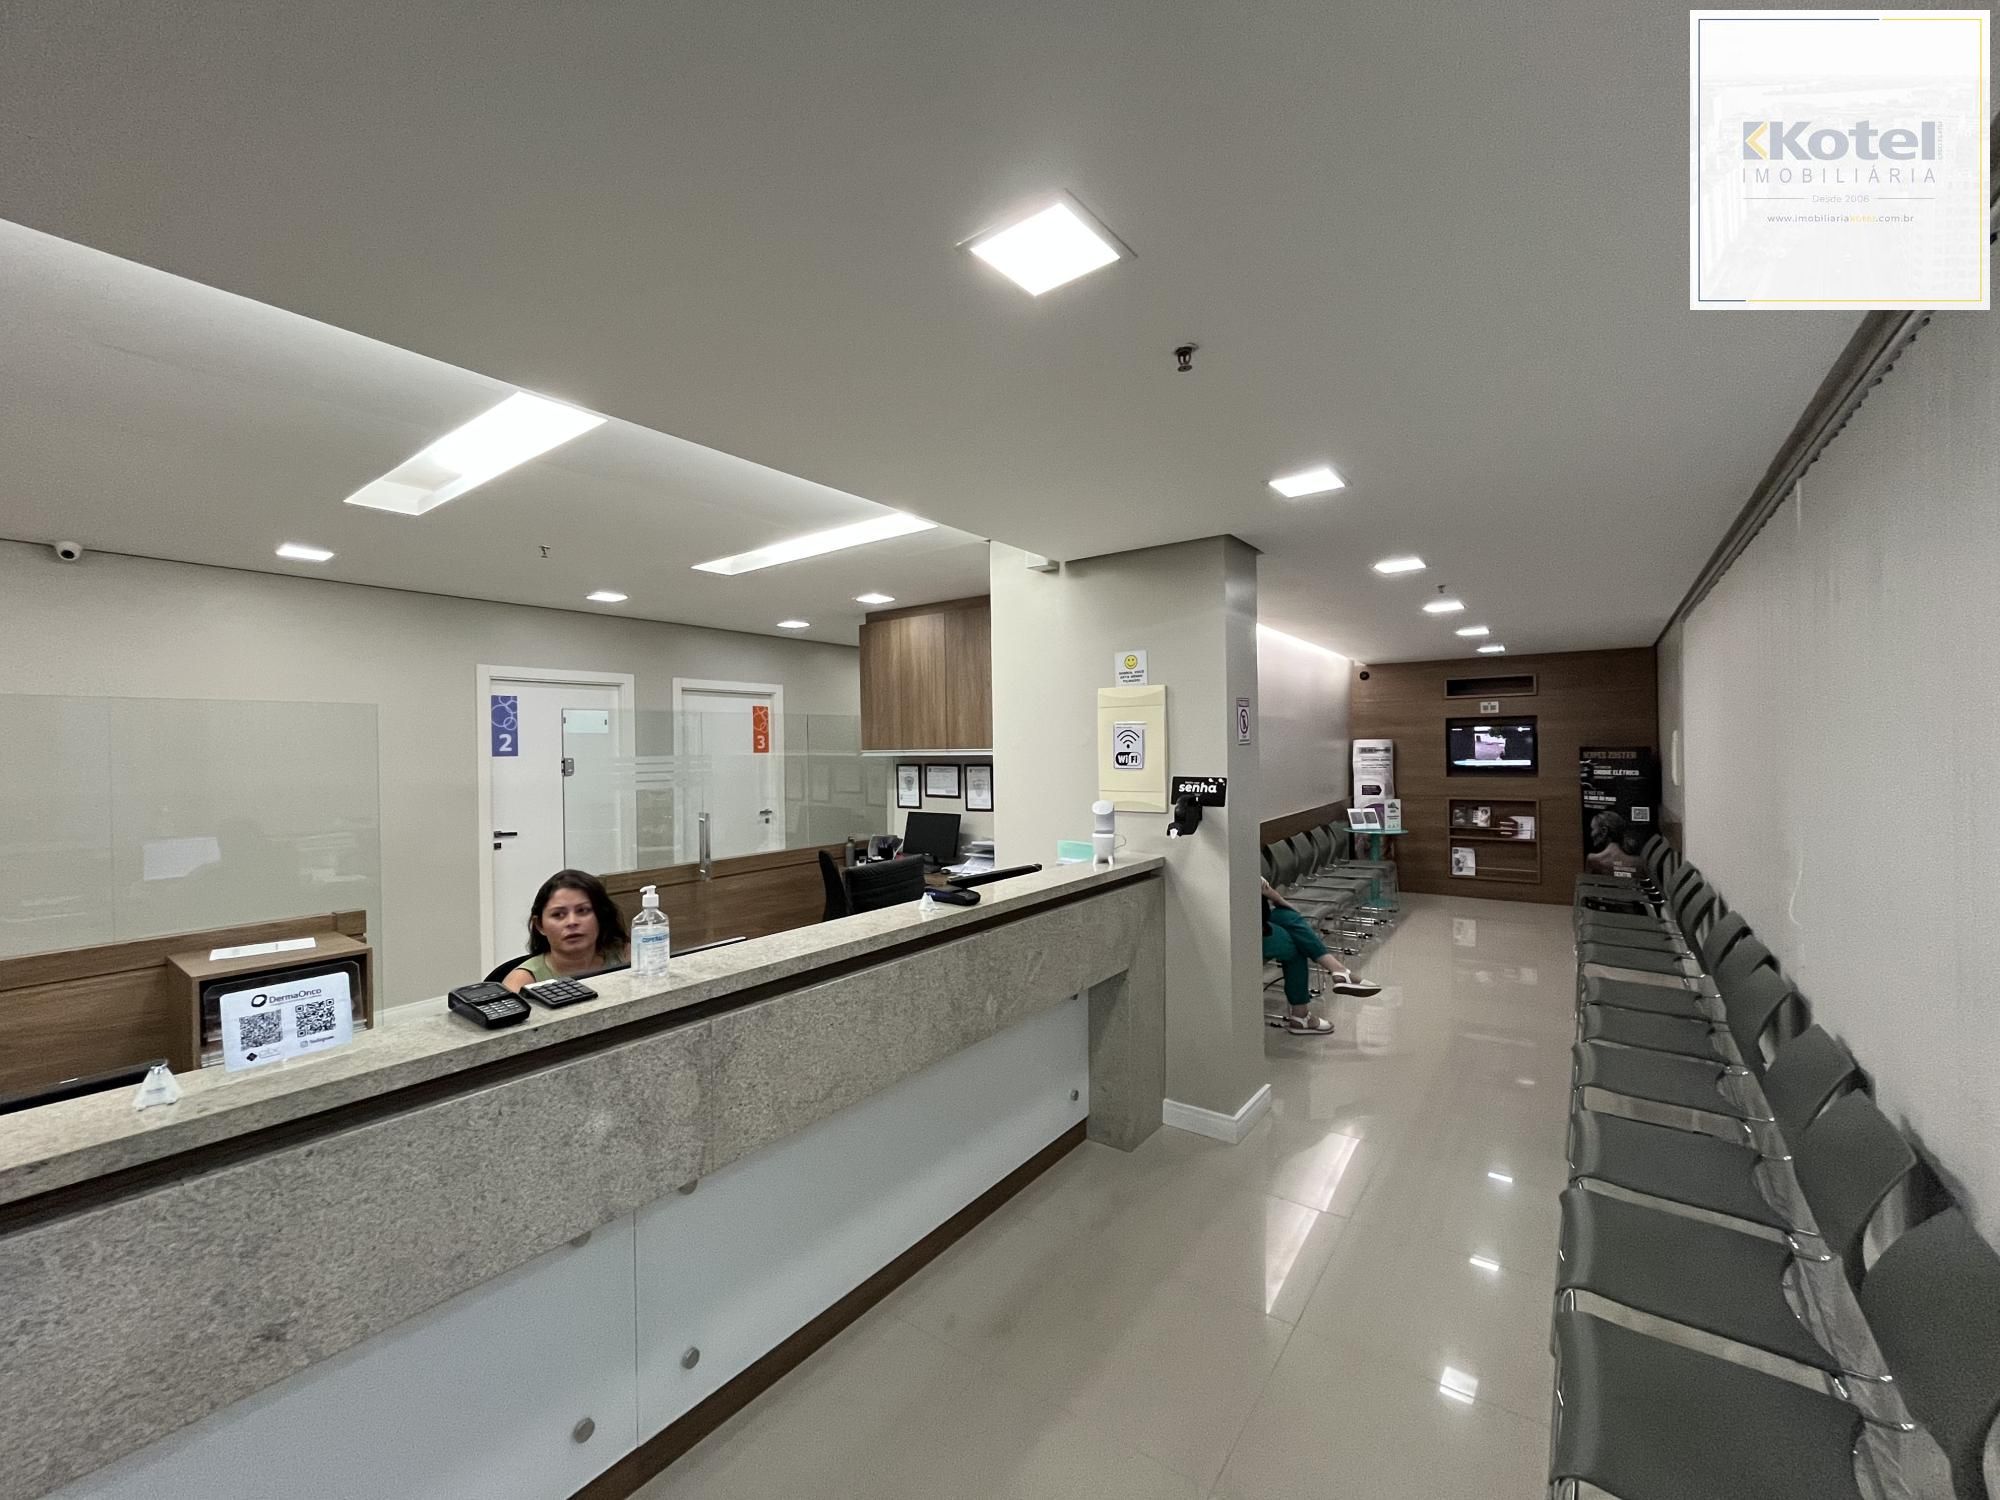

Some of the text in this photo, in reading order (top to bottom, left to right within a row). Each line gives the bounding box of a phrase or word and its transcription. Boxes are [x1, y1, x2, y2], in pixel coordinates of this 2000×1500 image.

[498, 733, 513, 752] 2
[757, 735, 766, 749] 3
[1178, 782, 1217, 793] senha
[269, 988, 322, 1003] DermaOnco
